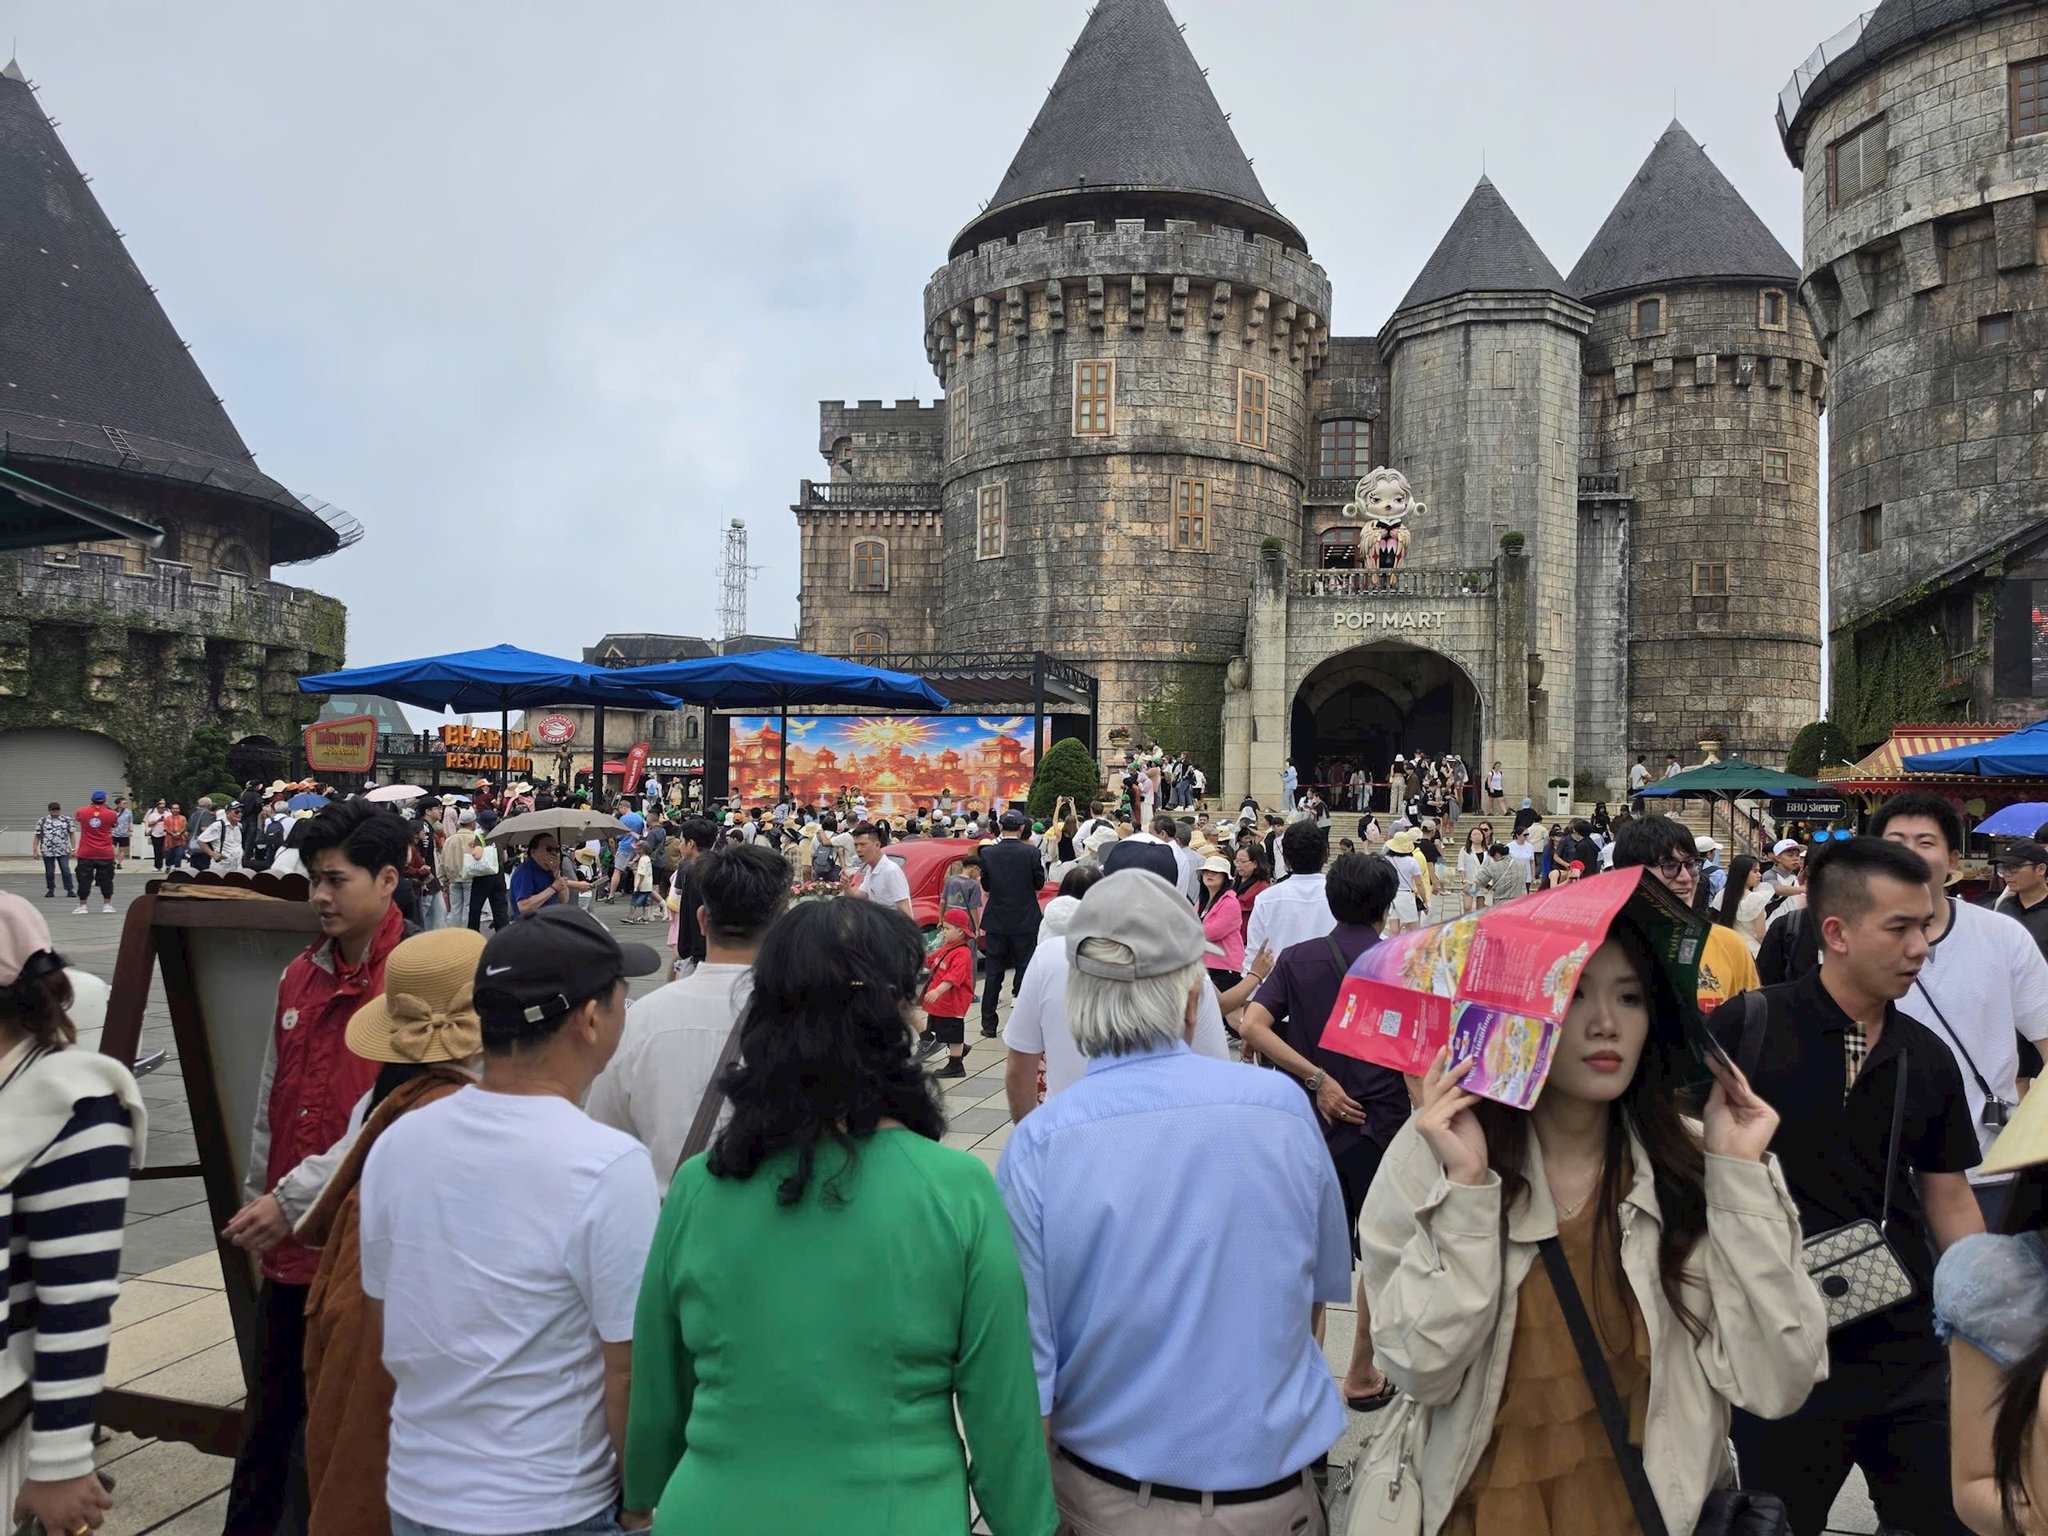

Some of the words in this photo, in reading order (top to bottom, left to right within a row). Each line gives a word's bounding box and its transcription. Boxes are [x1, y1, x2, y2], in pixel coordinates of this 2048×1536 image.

[1333, 612, 1375, 630] POP
[1382, 611, 1446, 629] MART
[540, 715, 573, 728] HIGHLANDS
[445, 725, 533, 751] BHARTA
[543, 734, 569, 742] COFFEE
[446, 752, 533, 772] RESTAUANT
[1786, 802, 1808, 813] BBQ
[1809, 802, 1841, 813] skewer
